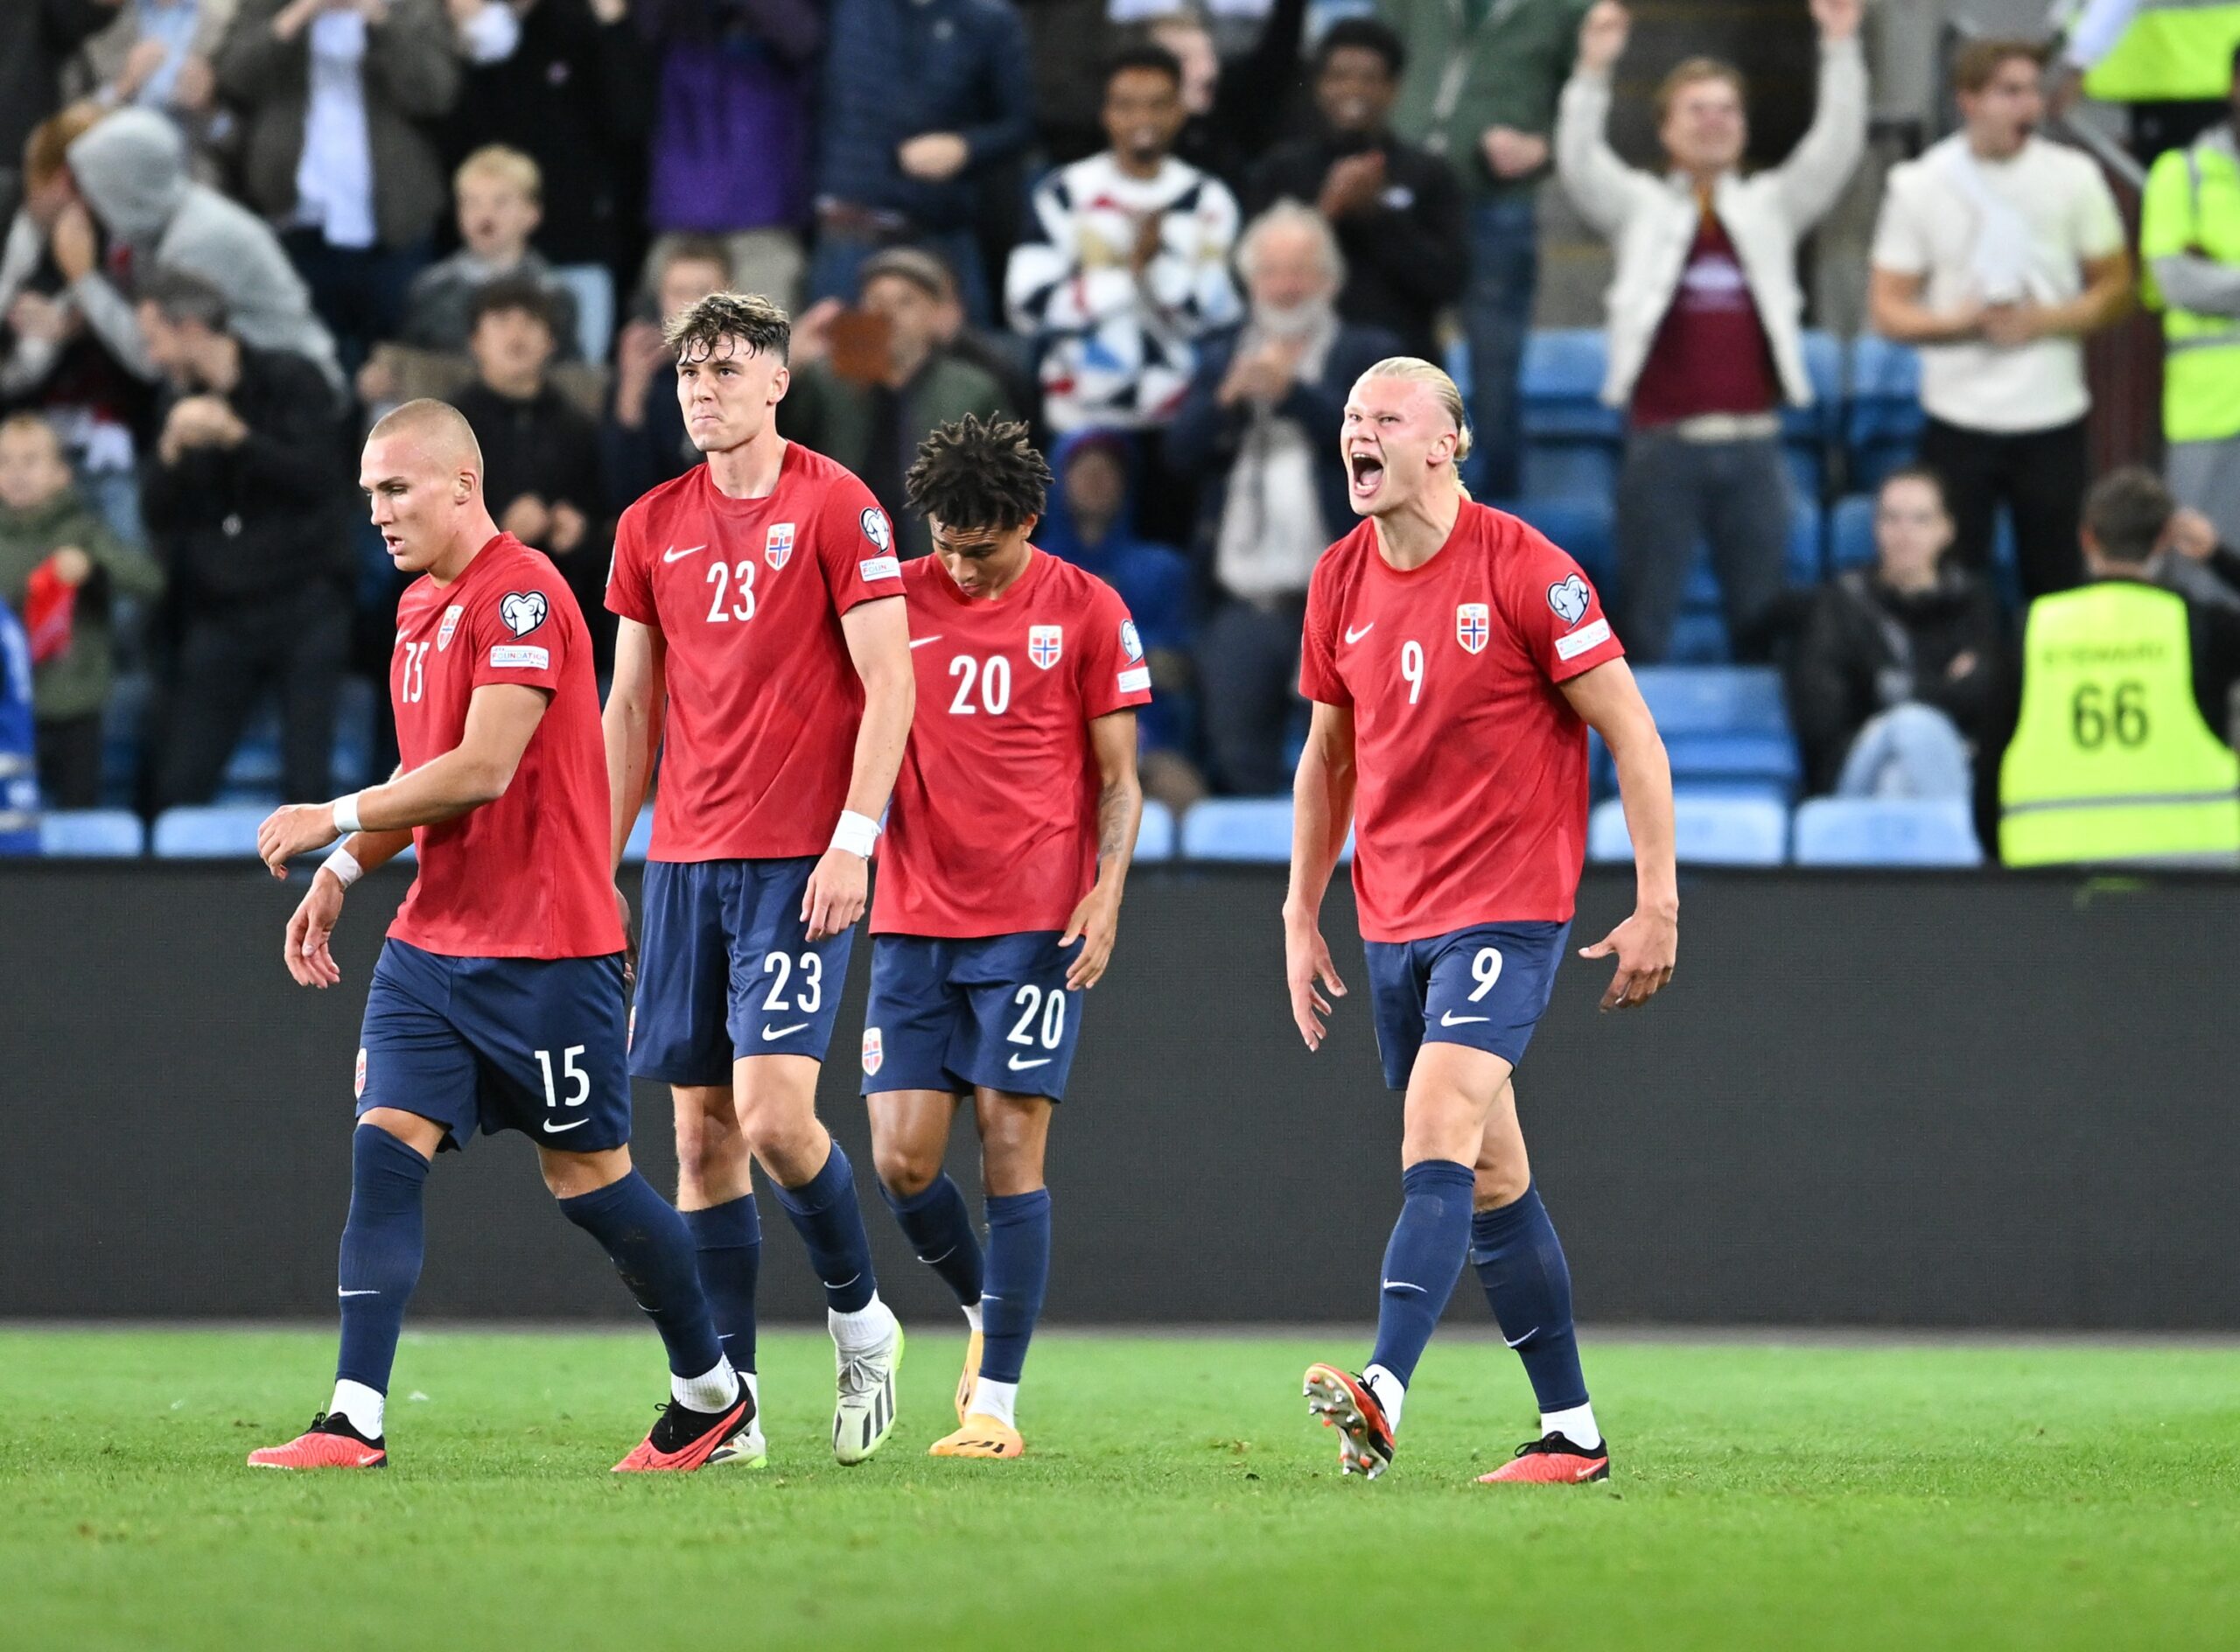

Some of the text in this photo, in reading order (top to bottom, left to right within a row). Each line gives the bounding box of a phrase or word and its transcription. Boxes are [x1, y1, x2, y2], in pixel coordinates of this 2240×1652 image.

[706, 560, 755, 623] 23
[948, 654, 1011, 715] 20
[1401, 640, 1424, 704] 9
[2072, 681, 2149, 751] 66
[762, 951, 822, 1013] 23
[1467, 947, 1503, 1002] 9
[1006, 984, 1065, 1049] 20
[535, 1045, 590, 1107] 15
